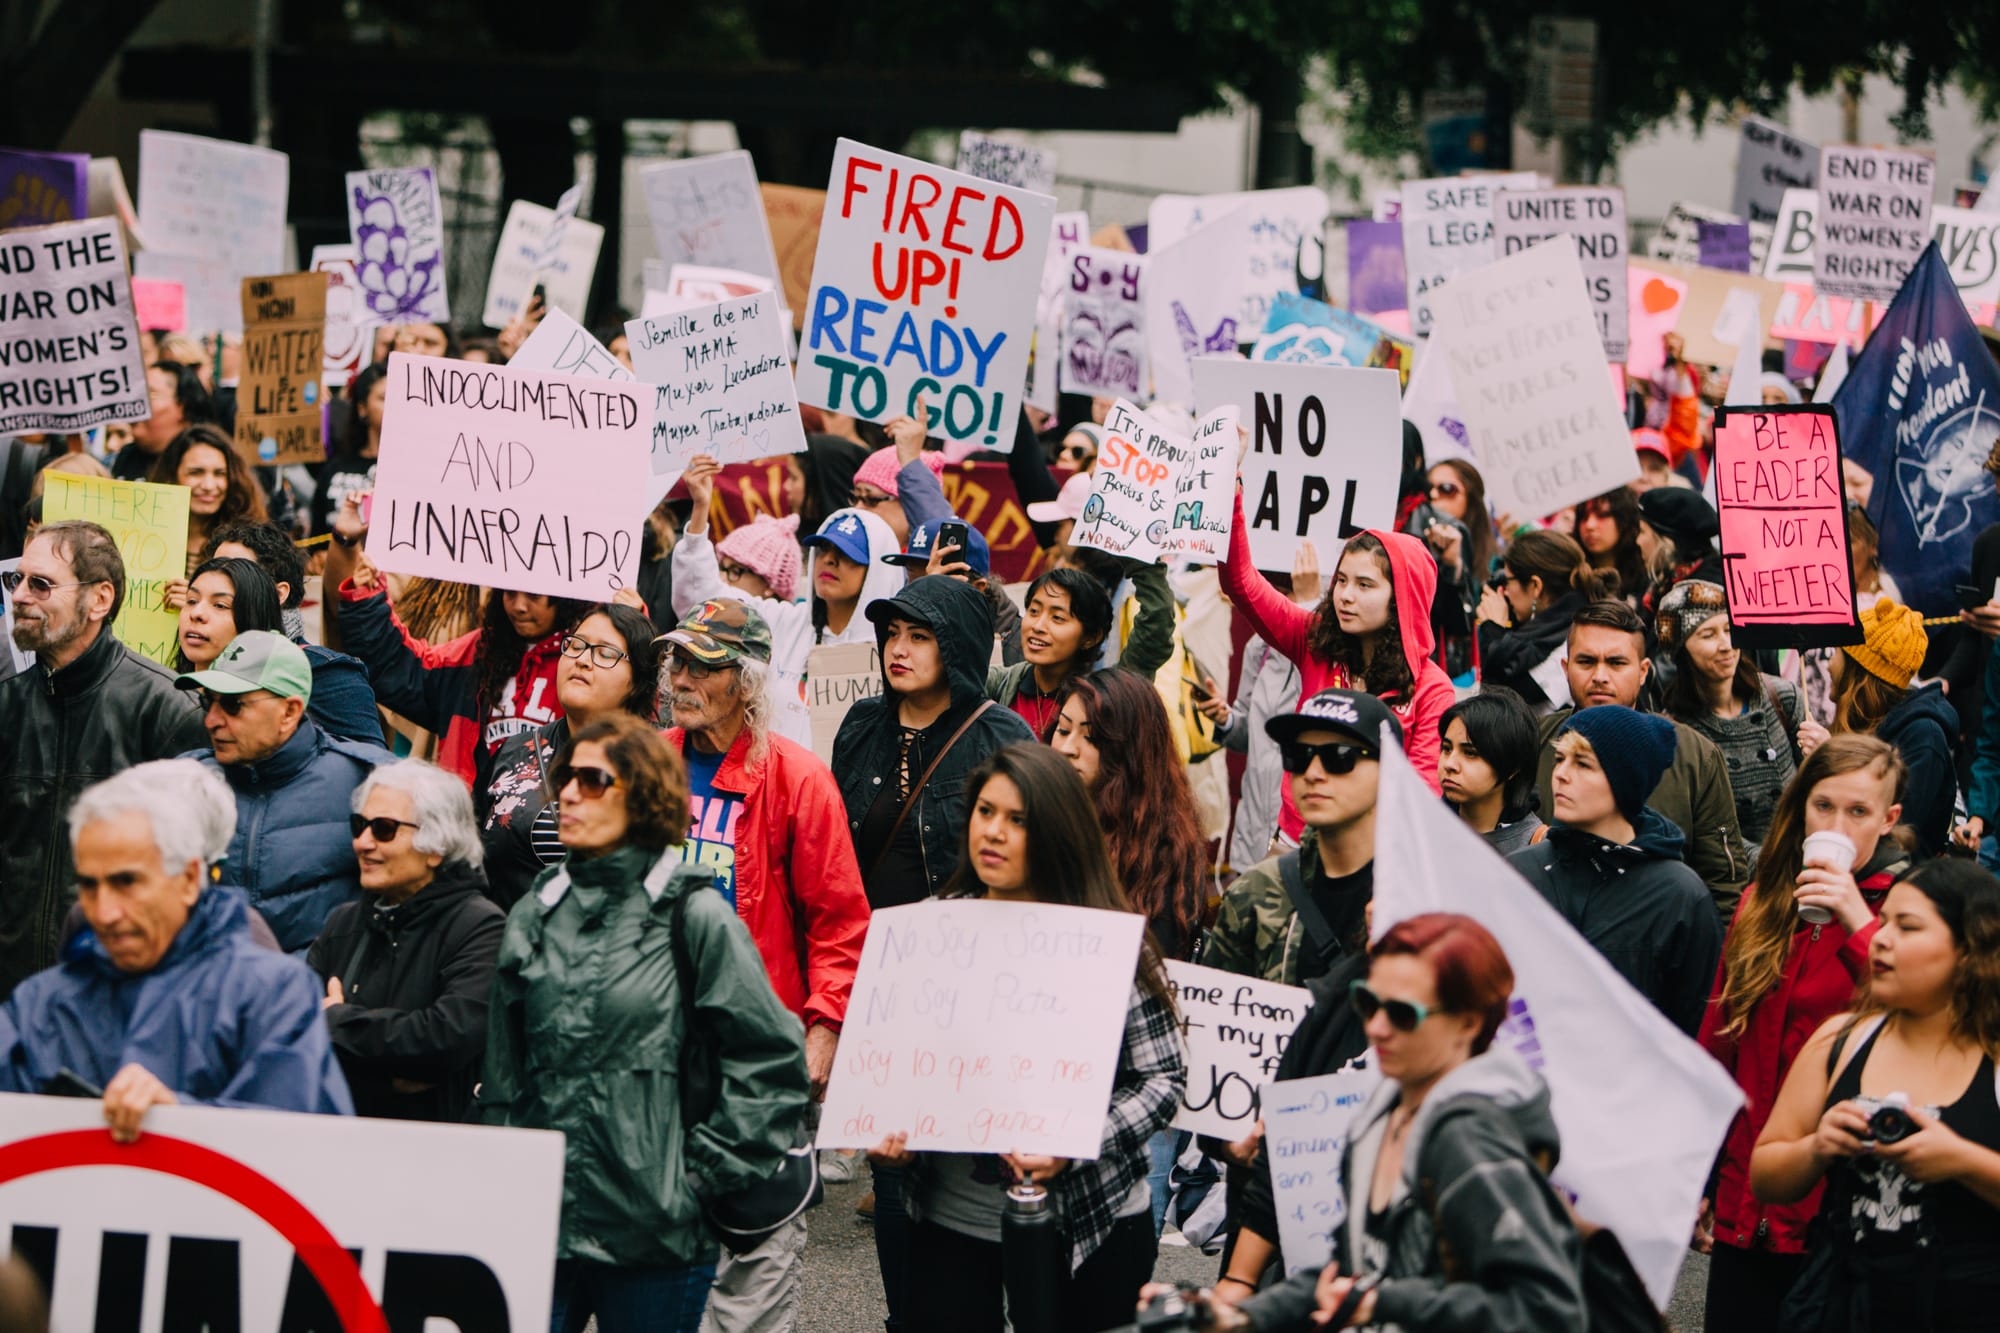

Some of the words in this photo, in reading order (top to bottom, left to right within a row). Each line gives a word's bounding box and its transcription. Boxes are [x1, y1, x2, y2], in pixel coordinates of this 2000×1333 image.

[1828, 155, 1876, 179] END
[1887, 159, 1930, 184] THE
[841, 156, 1024, 262] FIRED
[1425, 185, 1489, 211] SAFE
[1507, 197, 1577, 221] UNITE
[1586, 196, 1614, 218] TO
[1828, 192, 1880, 216] WAR
[1889, 196, 1922, 219] ON
[43, 232, 116, 271] THE
[1428, 221, 1495, 247] LEGA
[1824, 223, 1922, 251] WOMEN'S
[872, 241, 961, 319] UP!
[1824, 254, 1911, 282] RIGHTS
[66, 280, 117, 315] ON
[713, 303, 736, 328] de
[741, 300, 760, 321] mi
[246, 328, 321, 376] WATER
[809, 285, 1007, 388] READY
[254, 385, 298, 415] LIFE
[406, 362, 639, 431] UNDOCUMENTED
[814, 354, 888, 419] TO
[906, 377, 1004, 445] GO!
[1254, 391, 1327, 458] NO
[1753, 414, 1790, 451] BE
[1809, 414, 1828, 450] A
[440, 432, 535, 492] AND
[1098, 436, 1169, 487] STOP
[1718, 455, 1838, 503] LEADER
[52, 476, 173, 529] THERE
[1150, 489, 1168, 512] &
[1172, 499, 1229, 535] Minds
[389, 499, 632, 592] UNAFRAID!
[1762, 517, 1809, 549] NOT
[1816, 518, 1838, 550] A
[1722, 553, 1850, 608] TWEETER
[814, 676, 884, 706] HUMA
[879, 915, 917, 969] No
[926, 912, 979, 970] Soy
[1000, 911, 1105, 960] Santa
[866, 982, 898, 1027] Ni
[1229, 986, 1295, 1023] from
[1218, 1024, 1265, 1059] my
[849, 1039, 894, 1088] Soy
[949, 1054, 993, 1094] que
[1008, 1054, 1035, 1084] se
[1051, 1059, 1094, 1084] me
[843, 1104, 881, 1138] da
[912, 1104, 945, 1139] la
